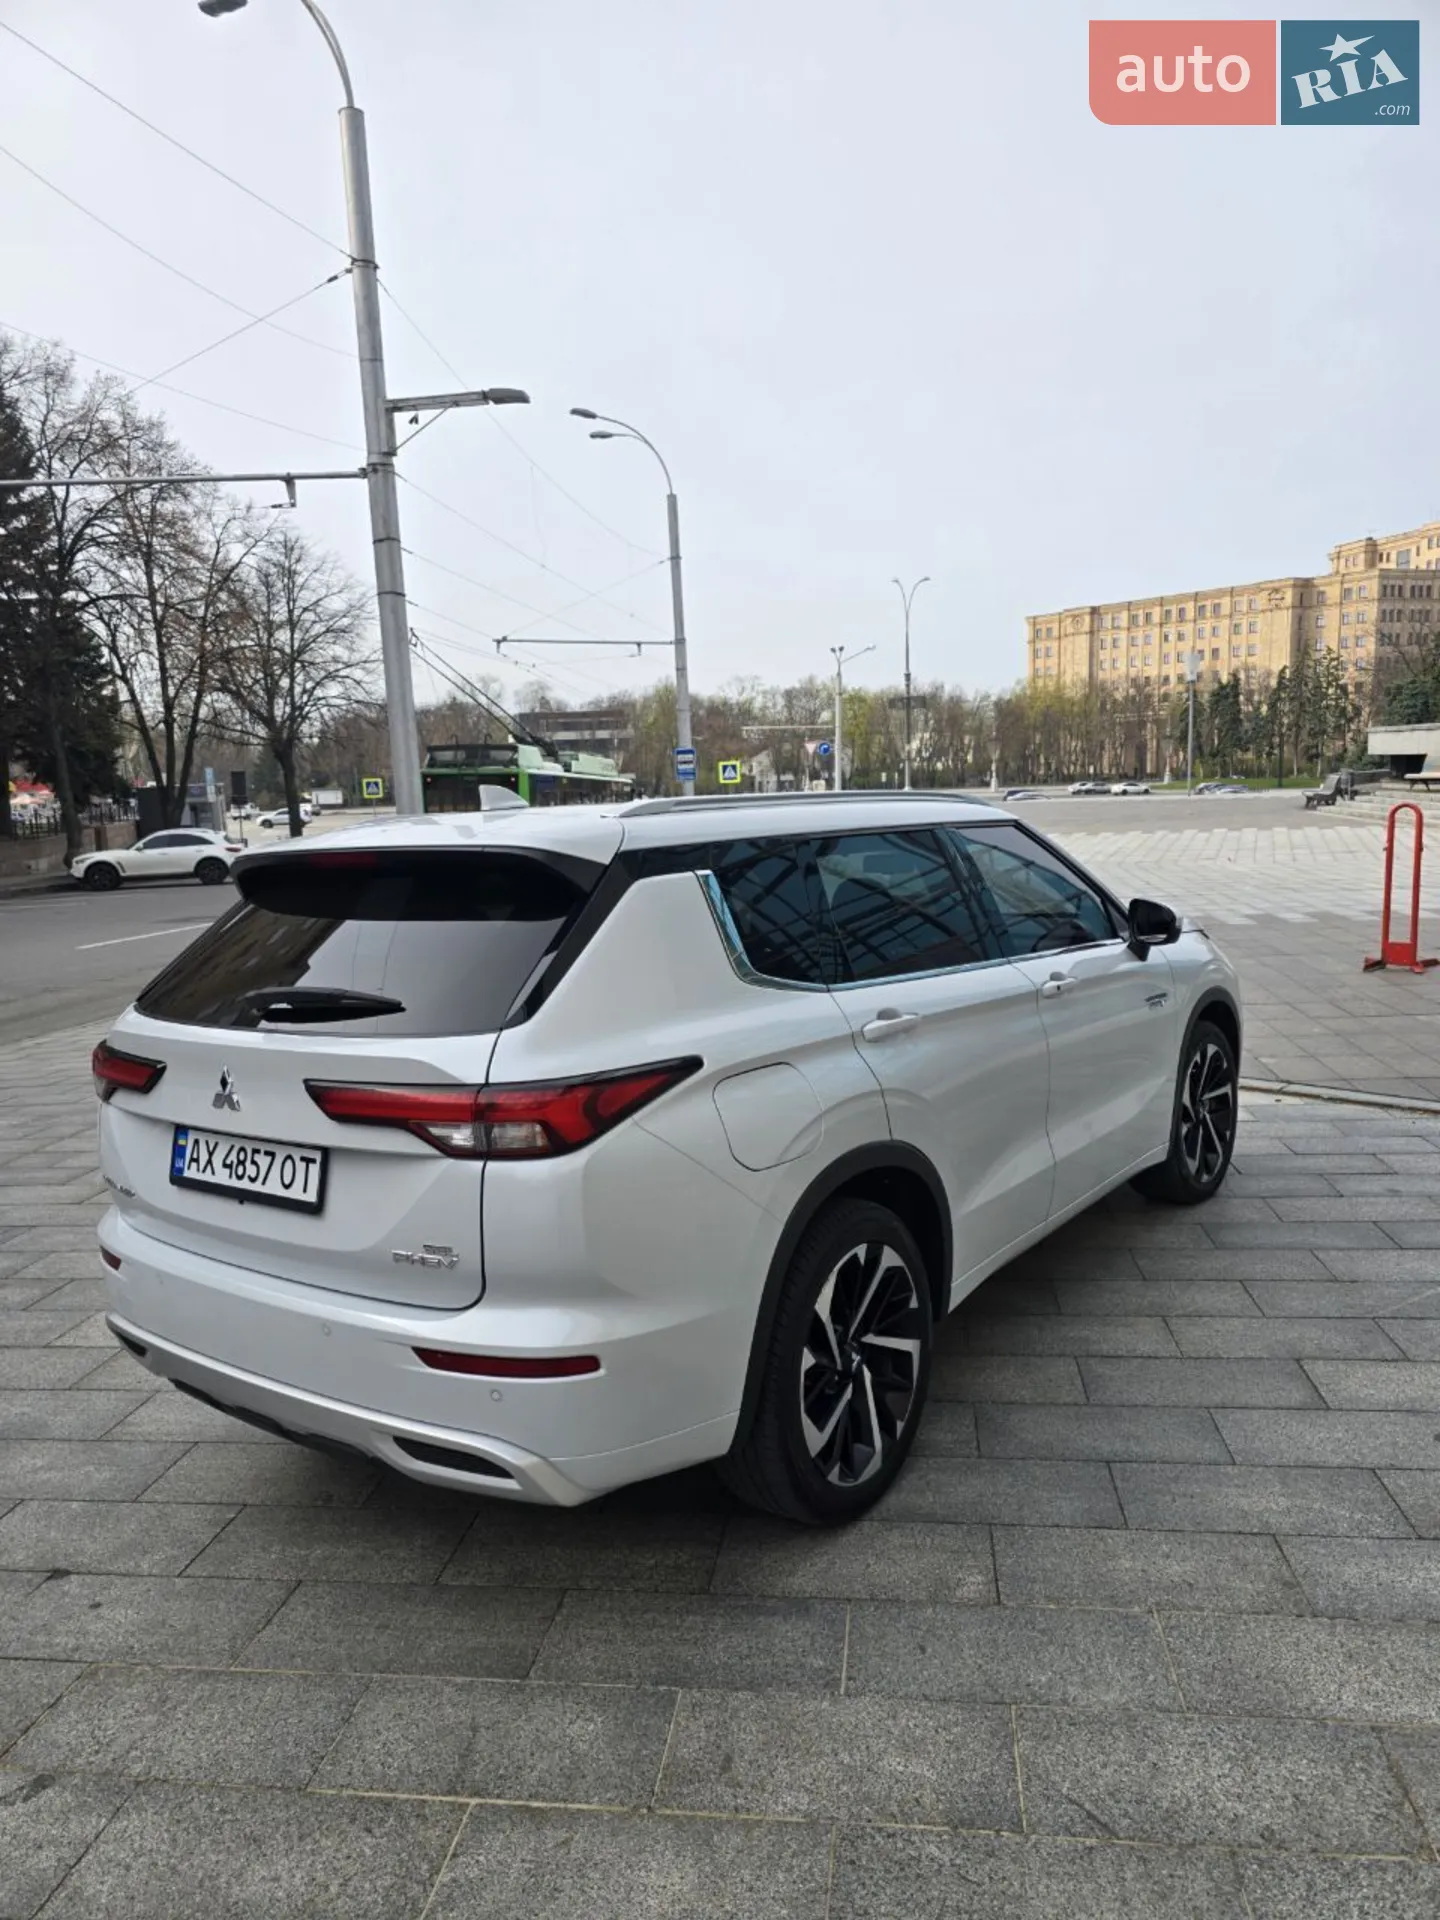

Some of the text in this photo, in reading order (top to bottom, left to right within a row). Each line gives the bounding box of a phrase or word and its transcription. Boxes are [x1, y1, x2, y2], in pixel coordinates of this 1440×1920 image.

[187, 1138, 317, 1194] AX 4857 OT
